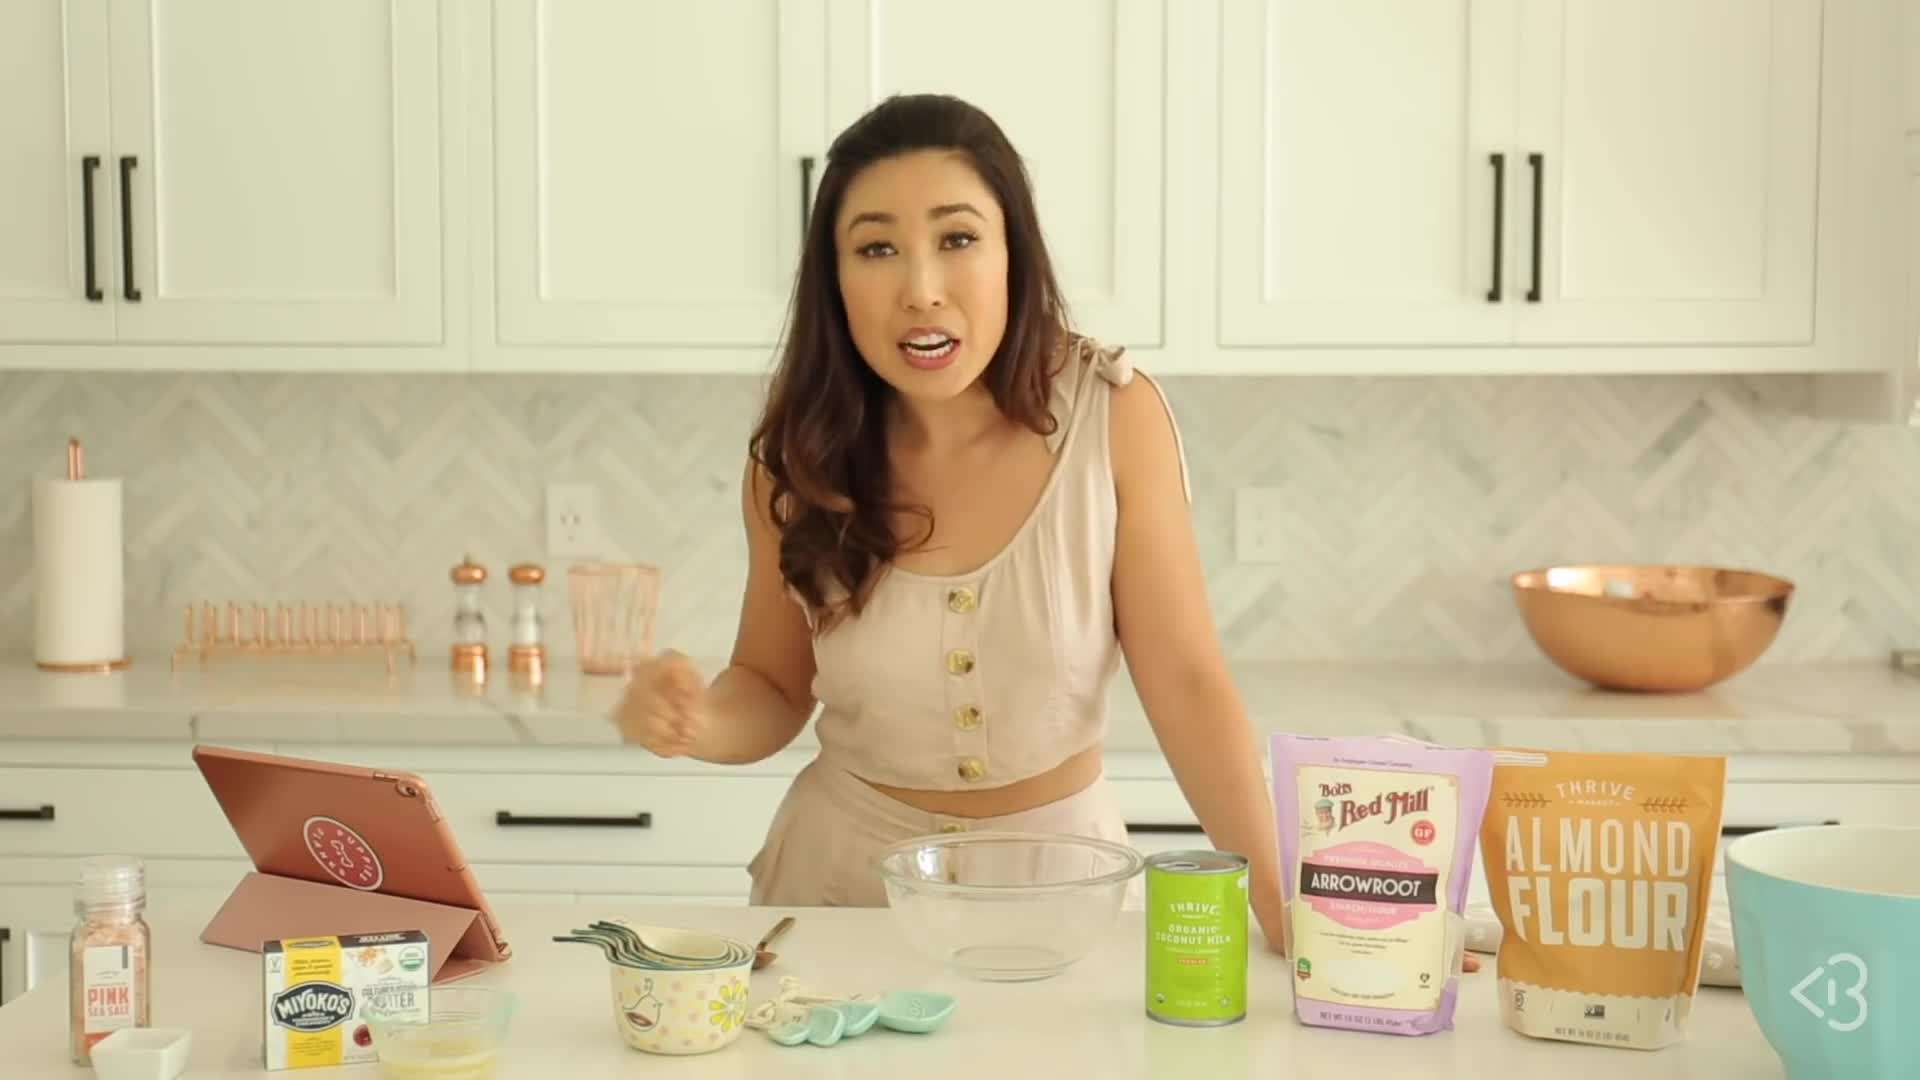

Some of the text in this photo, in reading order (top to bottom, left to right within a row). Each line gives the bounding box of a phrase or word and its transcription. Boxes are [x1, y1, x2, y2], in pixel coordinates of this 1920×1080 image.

[1556, 779, 1636, 801] THRIVE
[1338, 787, 1429, 832] Red Mill
[1505, 815, 1691, 877] ALMOND
[1311, 873, 1421, 897] ARROWROOT
[1507, 876, 1689, 952] FLOUR
[87, 986, 130, 1007] PINK
[277, 988, 349, 1019] MIYOKO'S
